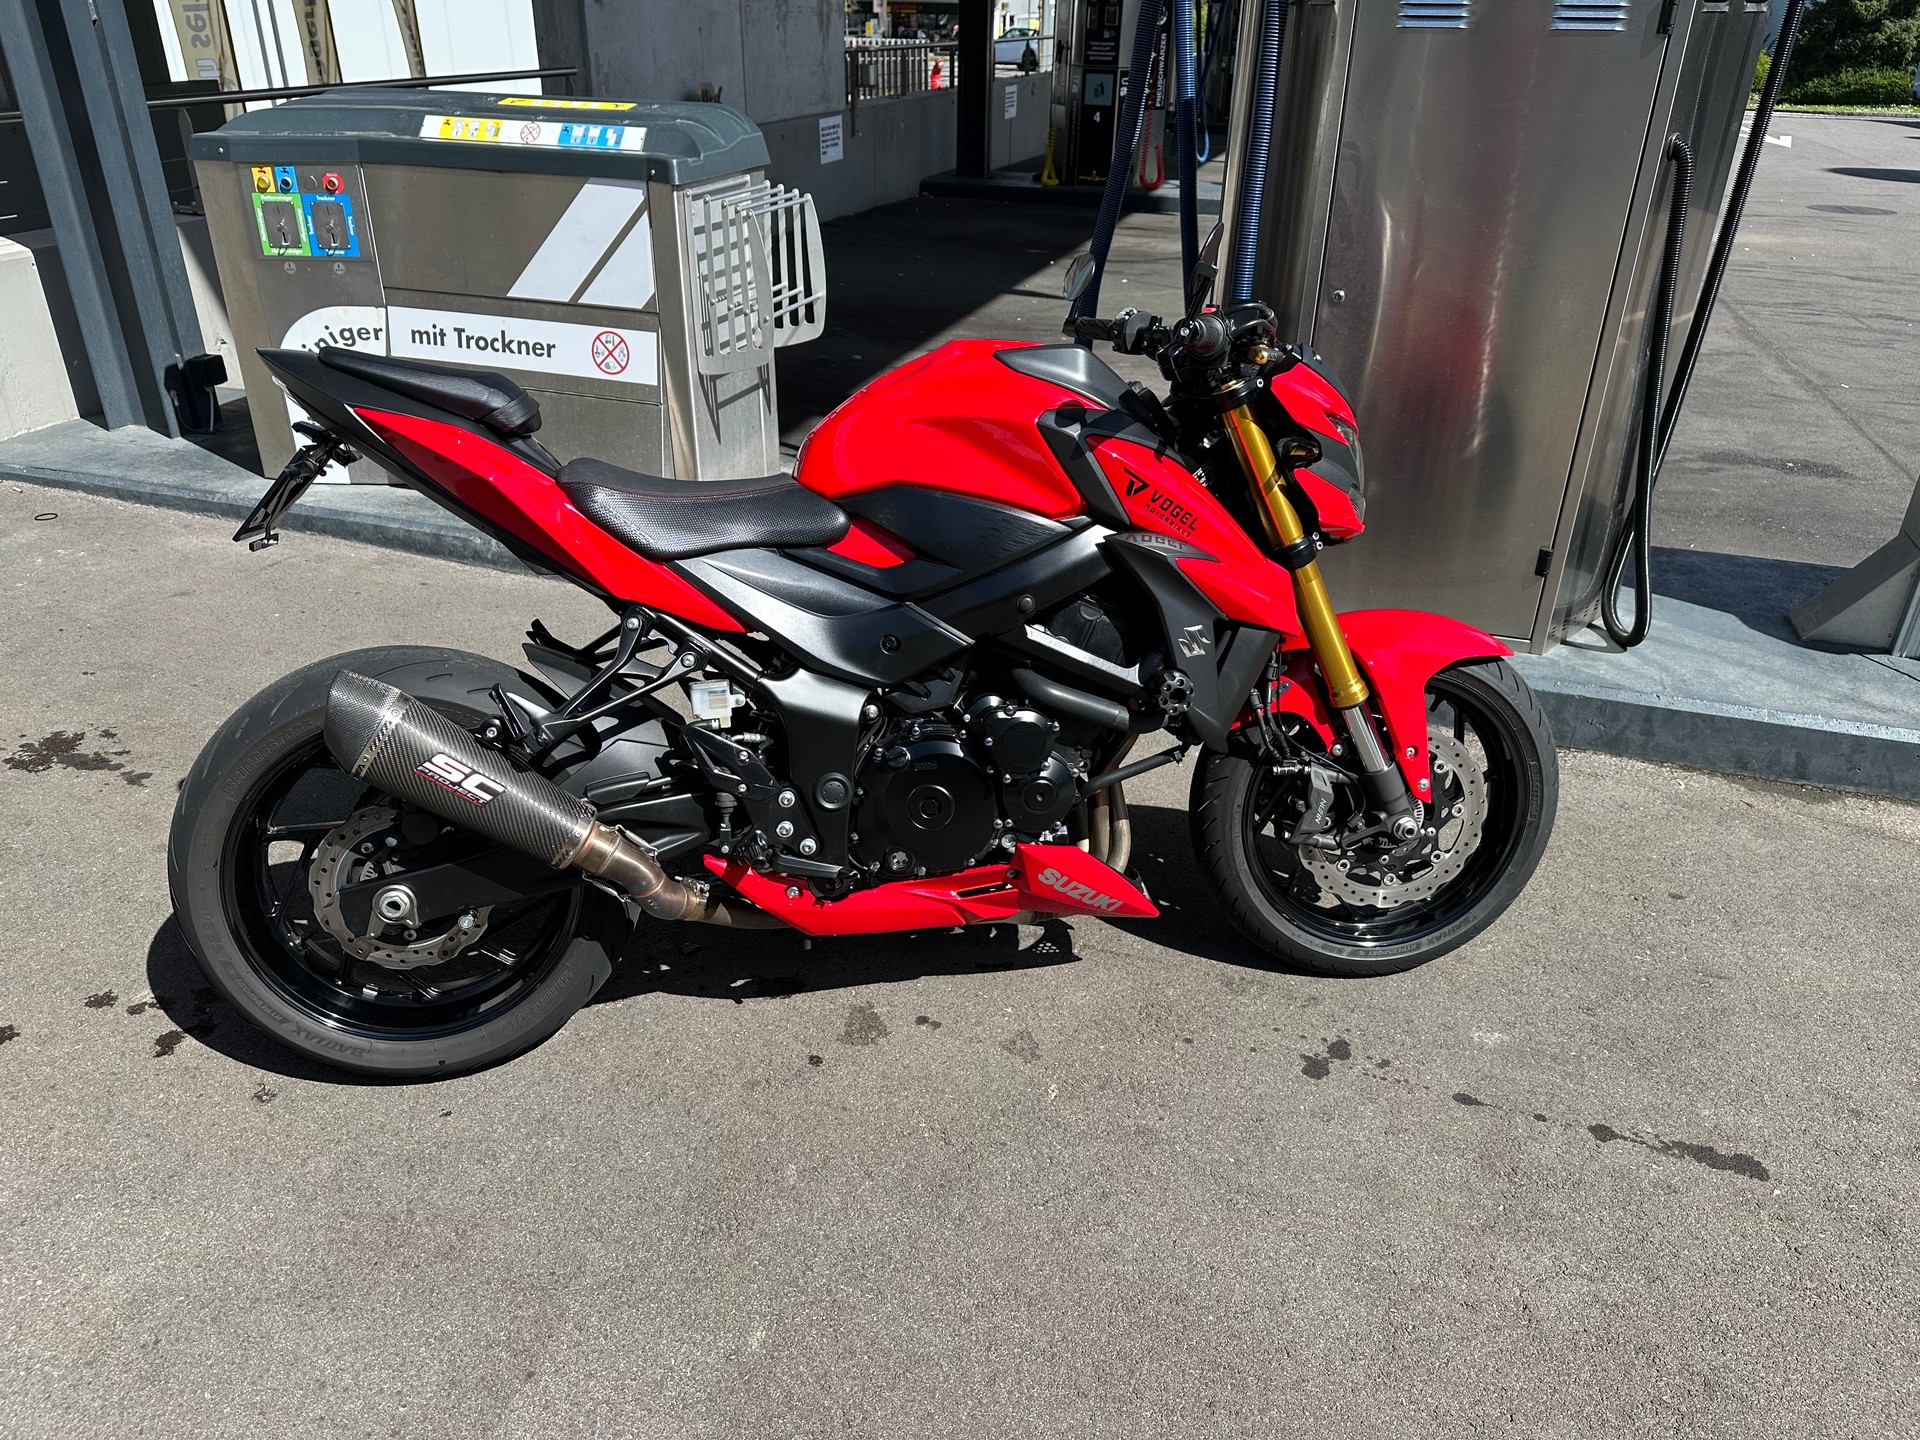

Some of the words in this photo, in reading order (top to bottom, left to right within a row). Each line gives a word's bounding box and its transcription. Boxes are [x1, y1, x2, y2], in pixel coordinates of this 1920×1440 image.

[1093, 111, 1100, 123] 4
[302, 325, 383, 352] niger
[411, 324, 447, 346] mit
[453, 327, 556, 358] Trockner
[1144, 503, 1192, 538] MOTORBIKES
[1150, 489, 1198, 531] VOGEL
[417, 765, 488, 804] PROJECT
[421, 753, 506, 801] SC
[1037, 867, 1124, 912] SUZUKI
